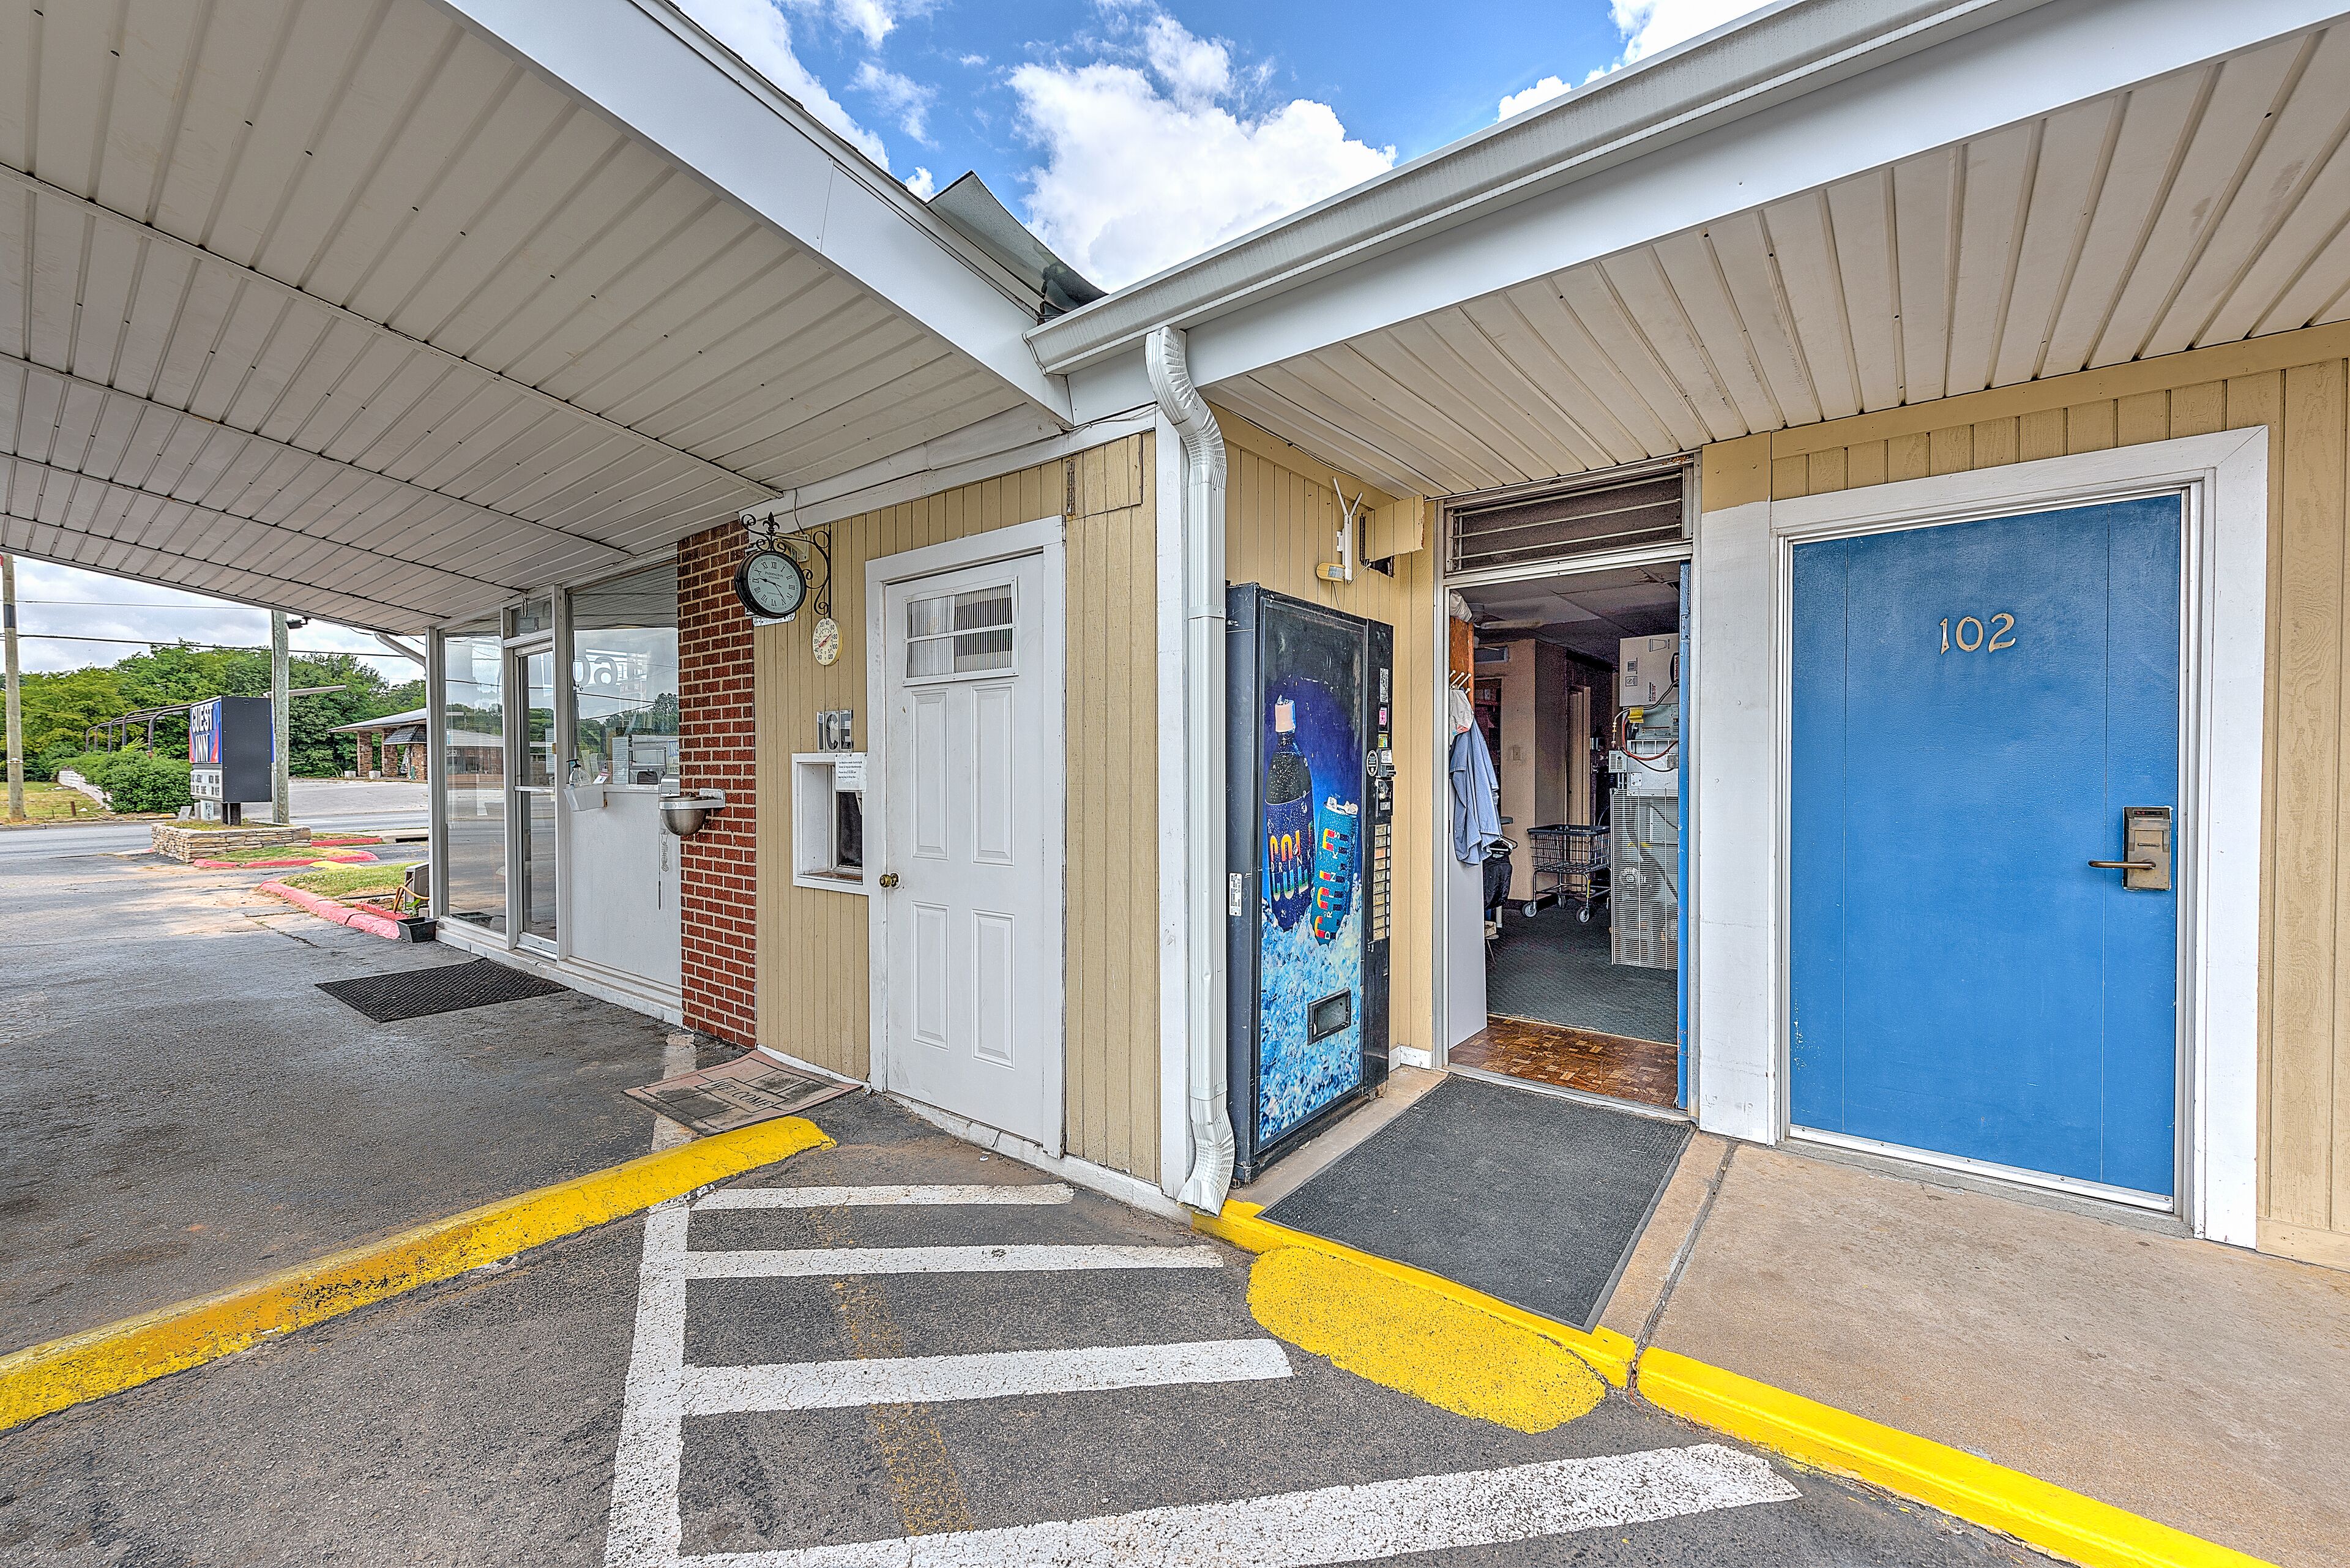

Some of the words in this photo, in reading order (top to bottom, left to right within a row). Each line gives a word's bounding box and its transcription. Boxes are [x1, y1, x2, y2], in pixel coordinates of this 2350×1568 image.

[1939, 613, 2016, 655] 102
[192, 703, 214, 733] GUEST
[818, 714, 851, 750] ICE
[195, 734, 209, 763] INN
[1324, 831, 1340, 940] DRINKS
[710, 1081, 774, 1108] WELCOME
